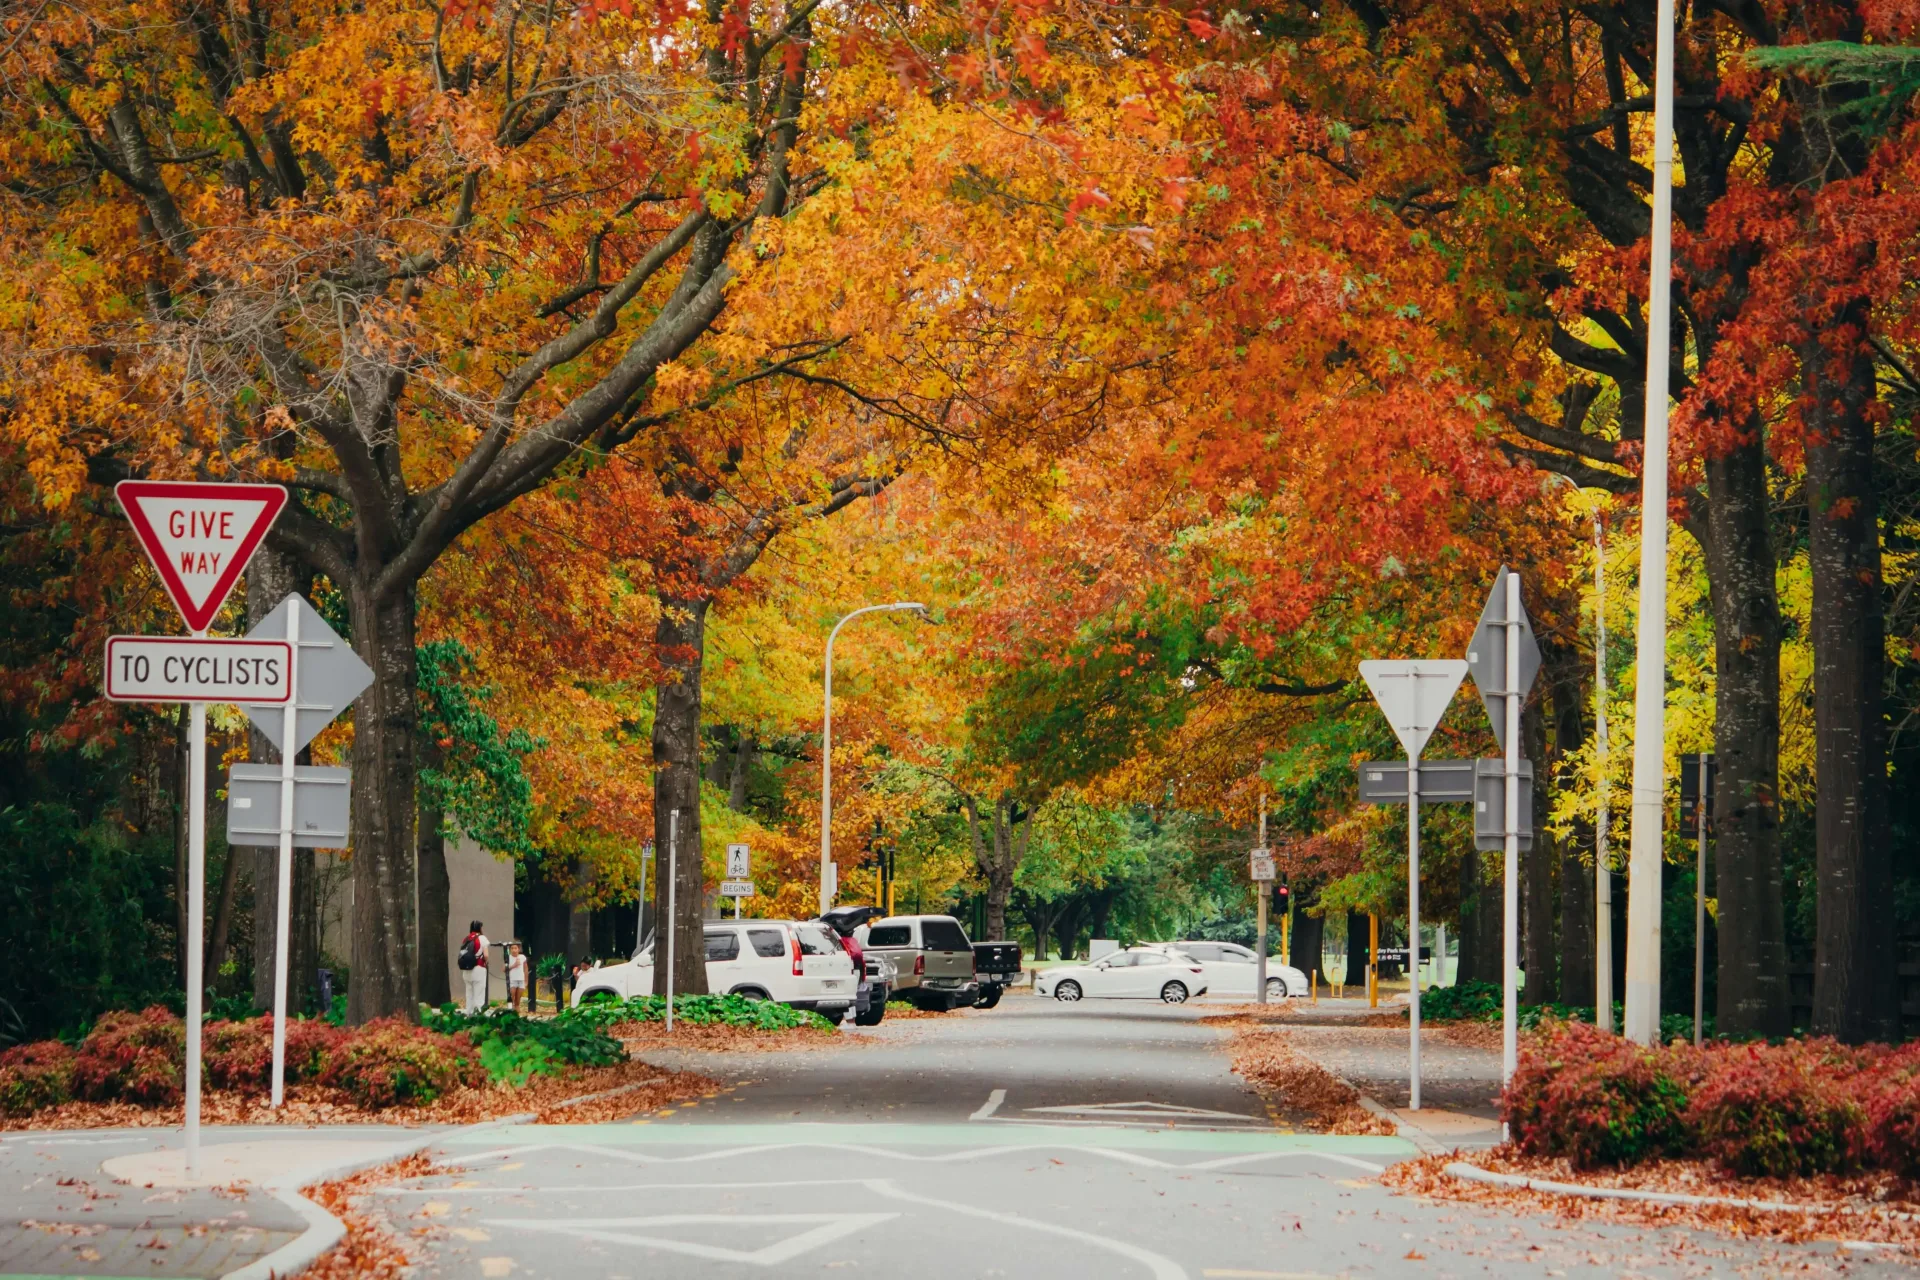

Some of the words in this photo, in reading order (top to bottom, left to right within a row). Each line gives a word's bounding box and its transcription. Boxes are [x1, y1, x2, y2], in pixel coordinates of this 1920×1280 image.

[169, 509, 234, 540] GIVE
[180, 551, 221, 575] WAY
[120, 654, 150, 683] TO
[163, 655, 280, 686] CYCLISTS
[723, 884, 752, 893] BEGINS
